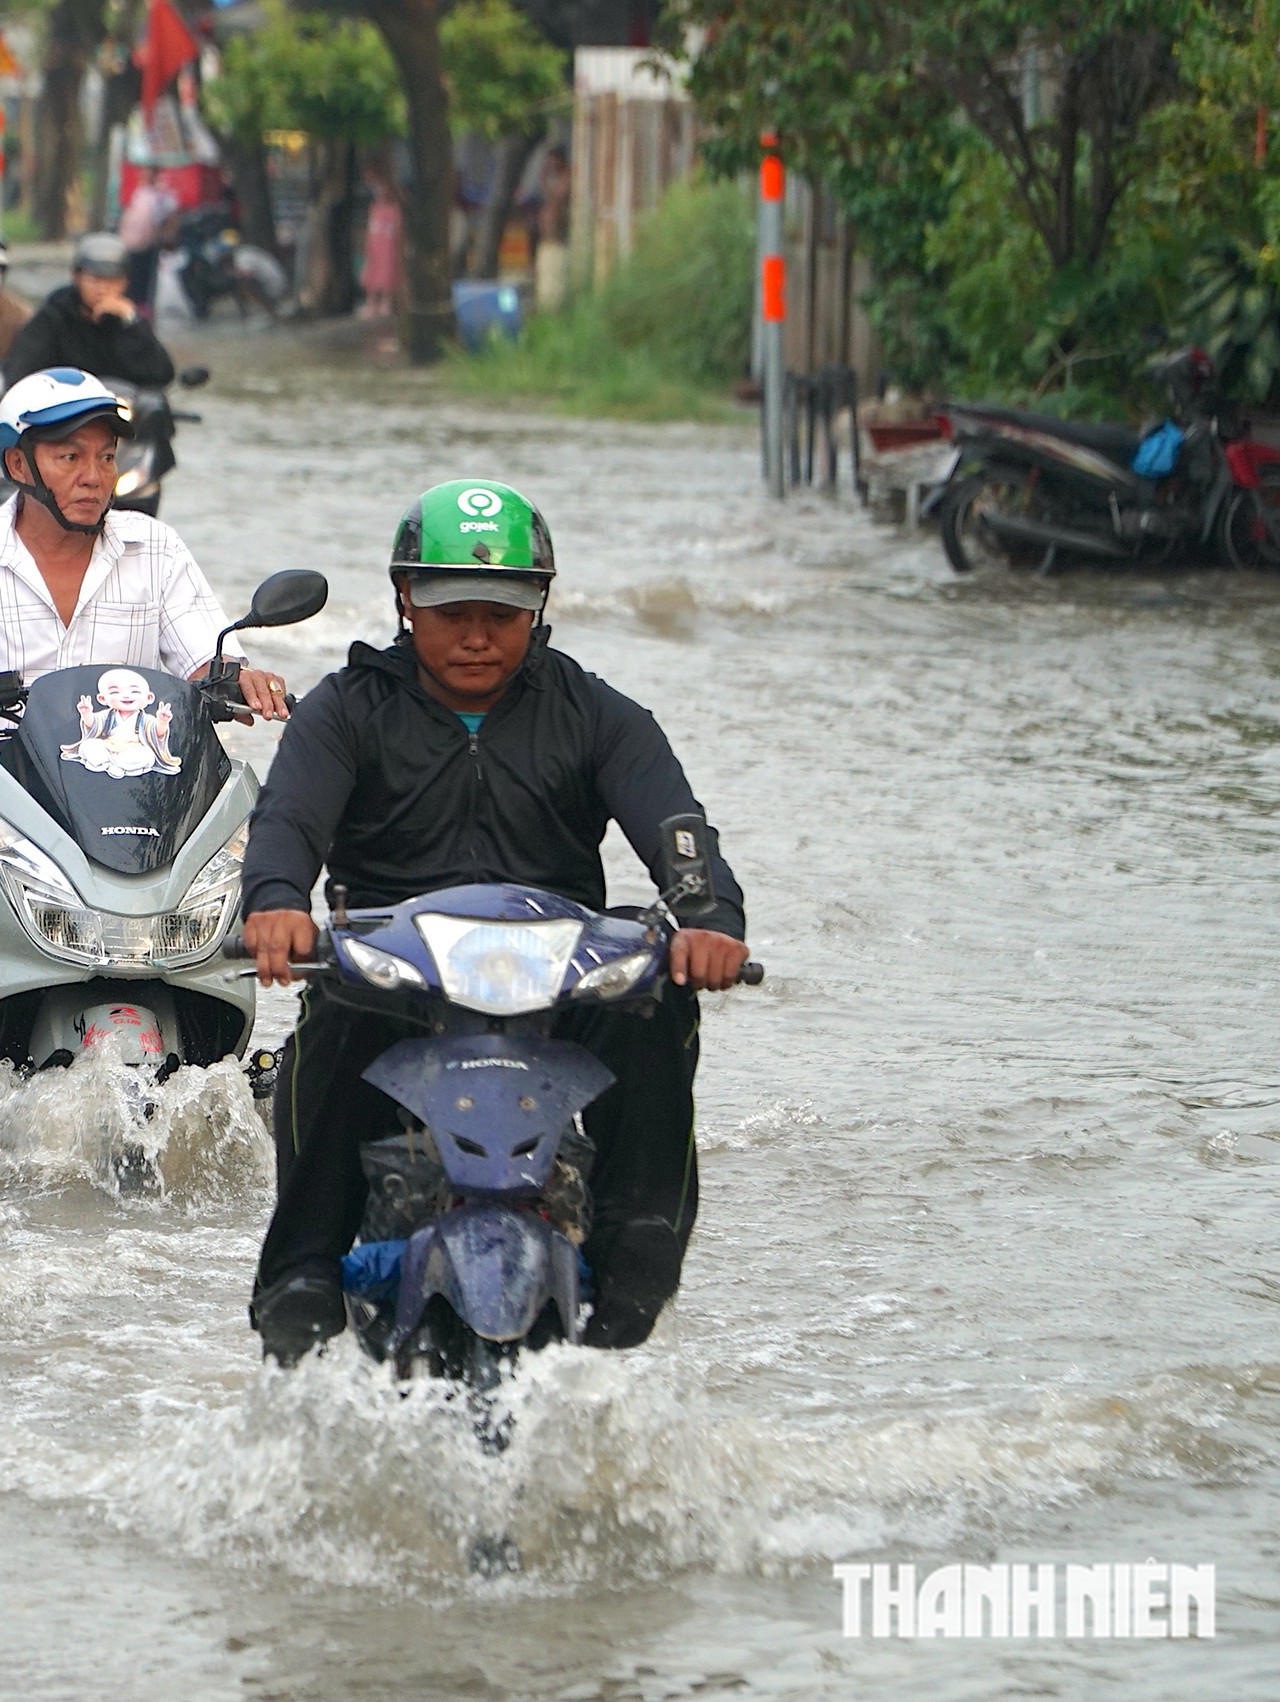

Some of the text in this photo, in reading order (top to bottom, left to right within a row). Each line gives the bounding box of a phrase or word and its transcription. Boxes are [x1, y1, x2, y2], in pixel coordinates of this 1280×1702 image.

[459, 521, 500, 533] gojek
[101, 826, 160, 837] HONDA
[113, 1018, 141, 1027] CLUB
[461, 1057, 529, 1071] HONDA
